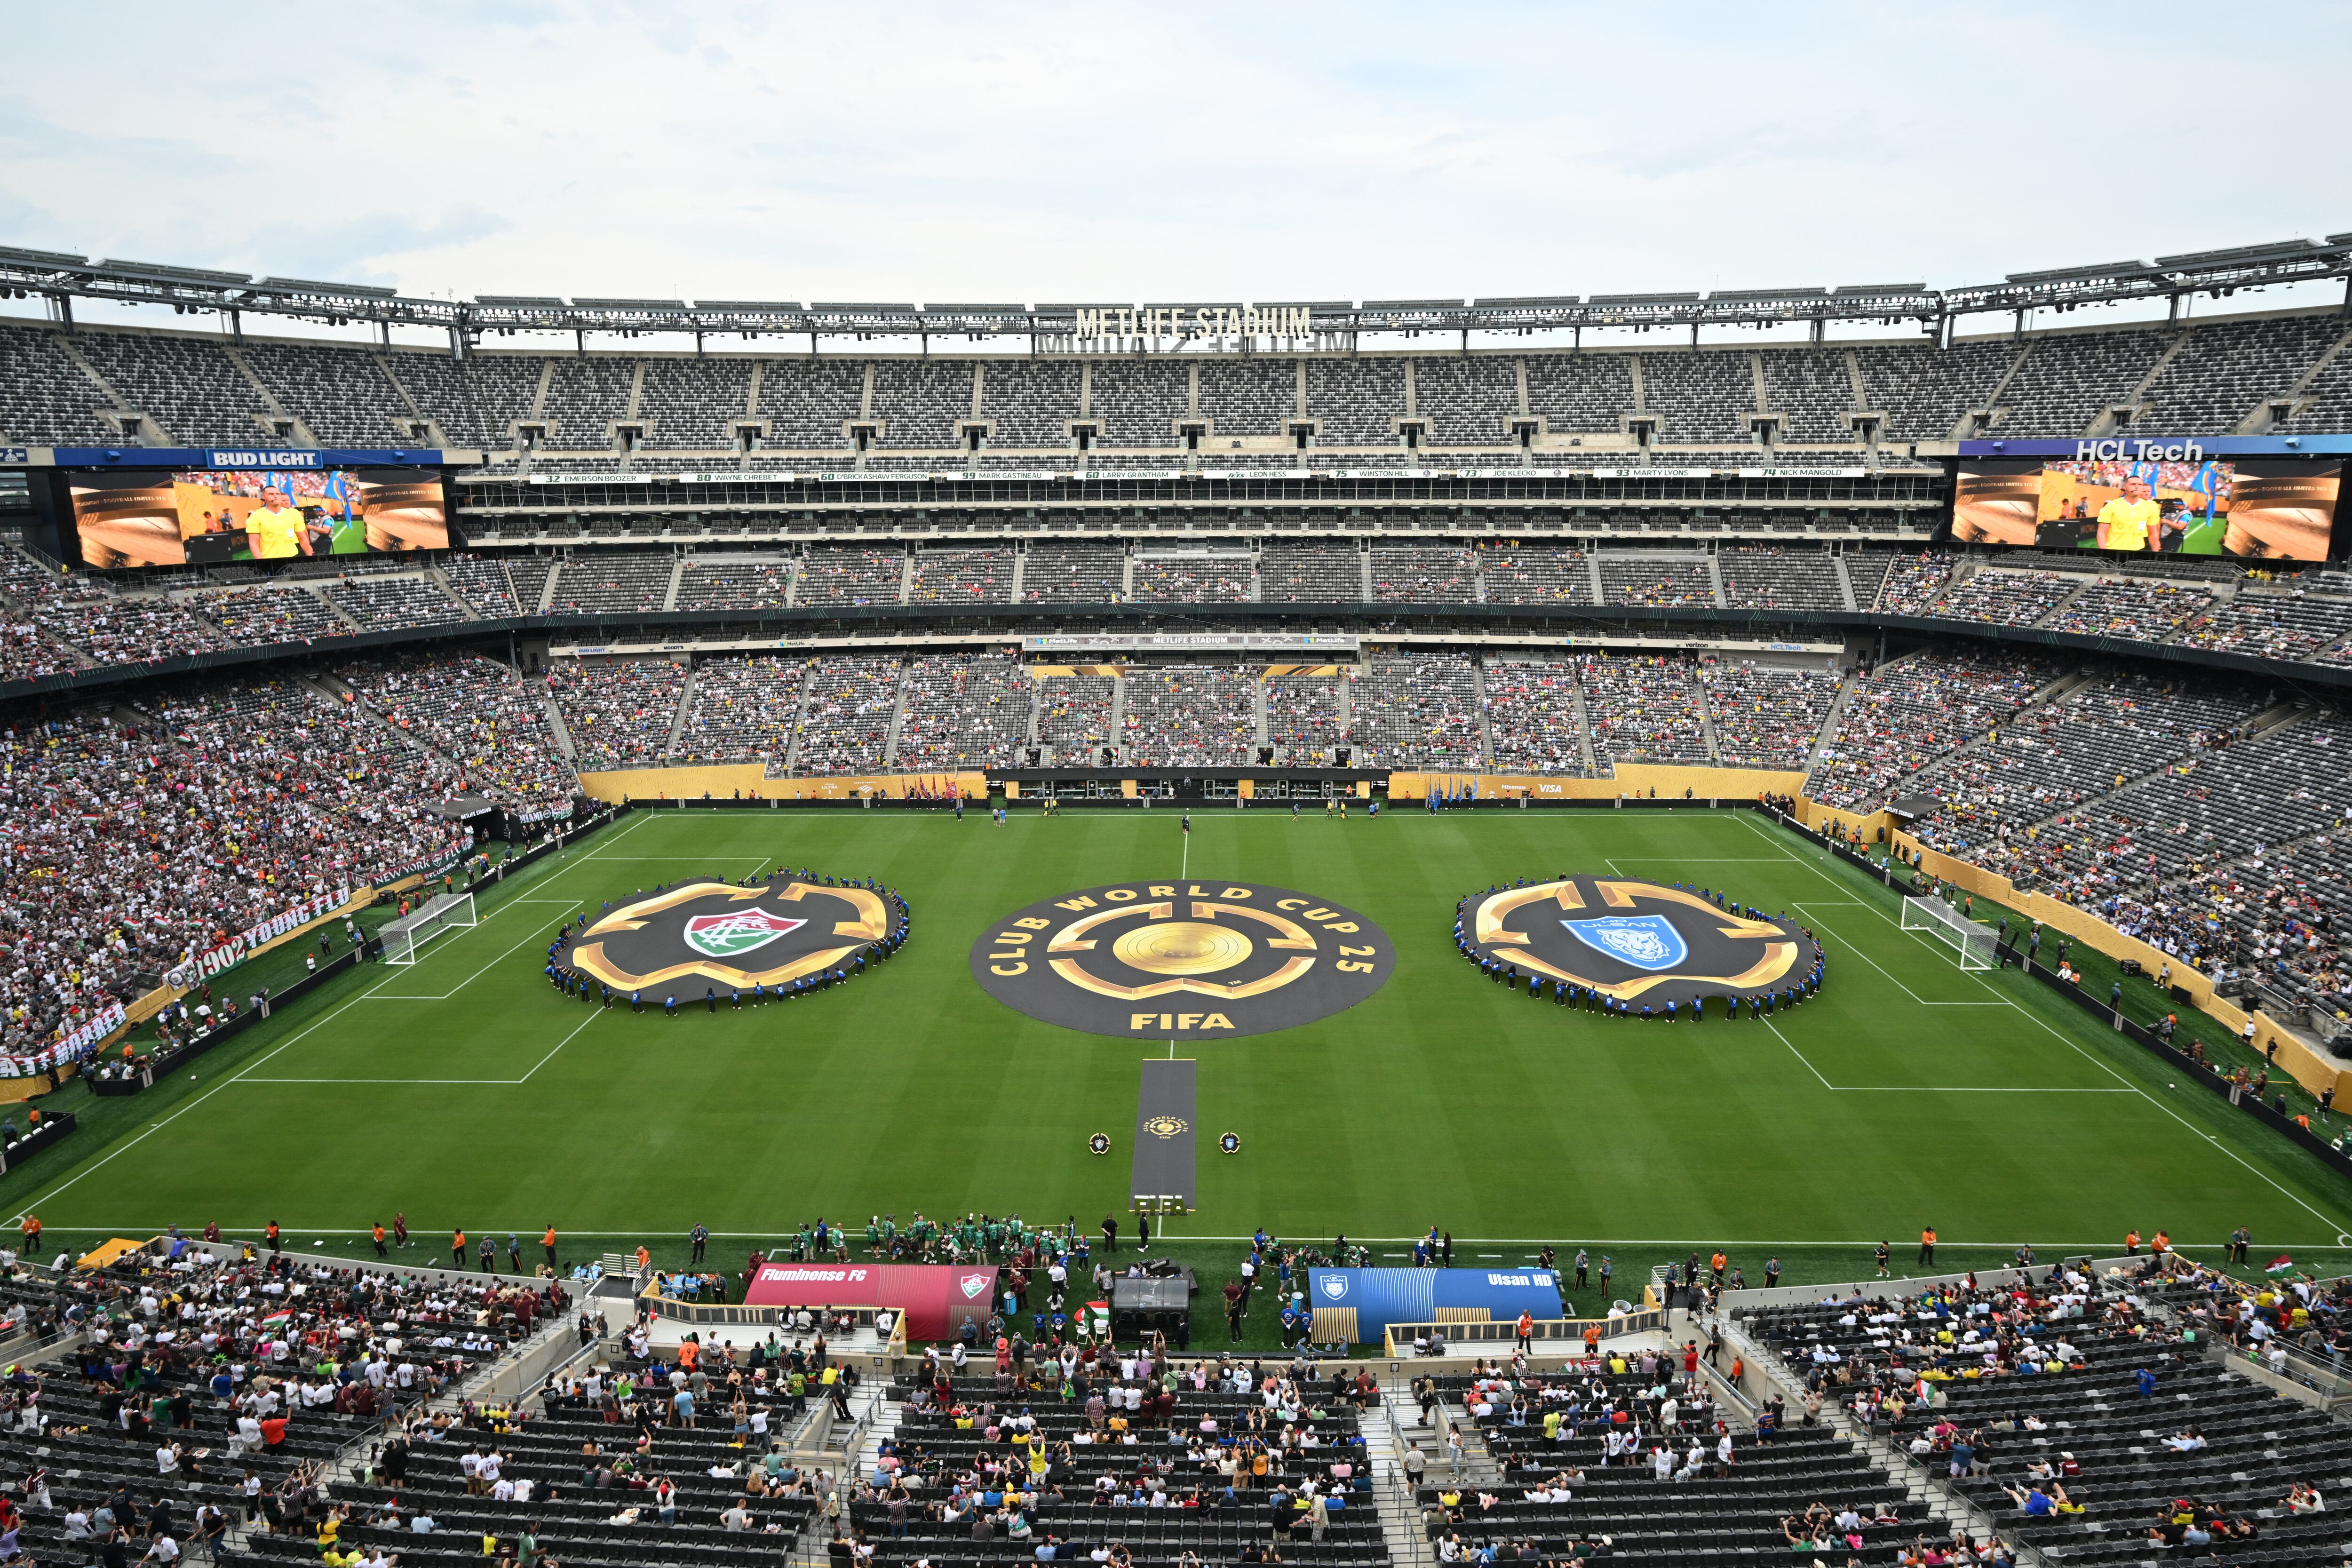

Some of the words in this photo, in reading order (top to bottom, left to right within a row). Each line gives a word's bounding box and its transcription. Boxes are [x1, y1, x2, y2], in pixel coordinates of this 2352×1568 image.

[1077, 308, 1185, 338] METLIFE
[1195, 307, 1310, 337] STADIUM
[2076, 439, 2203, 461] HCLTech
[214, 452, 258, 466] BUD
[259, 452, 316, 465] LIGHT
[1538, 784, 1562, 793] VISA
[461, 811, 476, 820] METLIFE
[476, 806, 492, 815] STADIUM
[519, 811, 543, 824] MIAMI
[1884, 805, 1899, 814] METLIFE
[1898, 810, 1914, 819] STADIUM
[445, 846, 461, 860] FLU
[373, 868, 402, 884] NEW
[402, 856, 430, 874] YORK
[242, 905, 310, 948] YOUNG
[313, 887, 350, 917] FLU
[989, 917, 1051, 976] CLUB
[1053, 884, 1253, 912] WORLD
[1276, 898, 1360, 934] CUP
[1336, 945, 1376, 975] 25
[196, 935, 246, 981] 1902
[1130, 1012, 1236, 1029] FIFA
[1134, 1195, 1189, 1216] FIFA
[760, 1268, 845, 1281] Fluminense
[847, 1269, 867, 1281] FC
[1488, 1274, 1529, 1286] Ulsan
[1533, 1274, 1552, 1287] HD
[1629, 1365, 1639, 1373] 10
[1551, 1420, 1558, 1429] 10
[485, 1463, 495, 1473] 14
[1681, 1473, 1688, 1481] 18
[498, 1490, 504, 1499] 3
